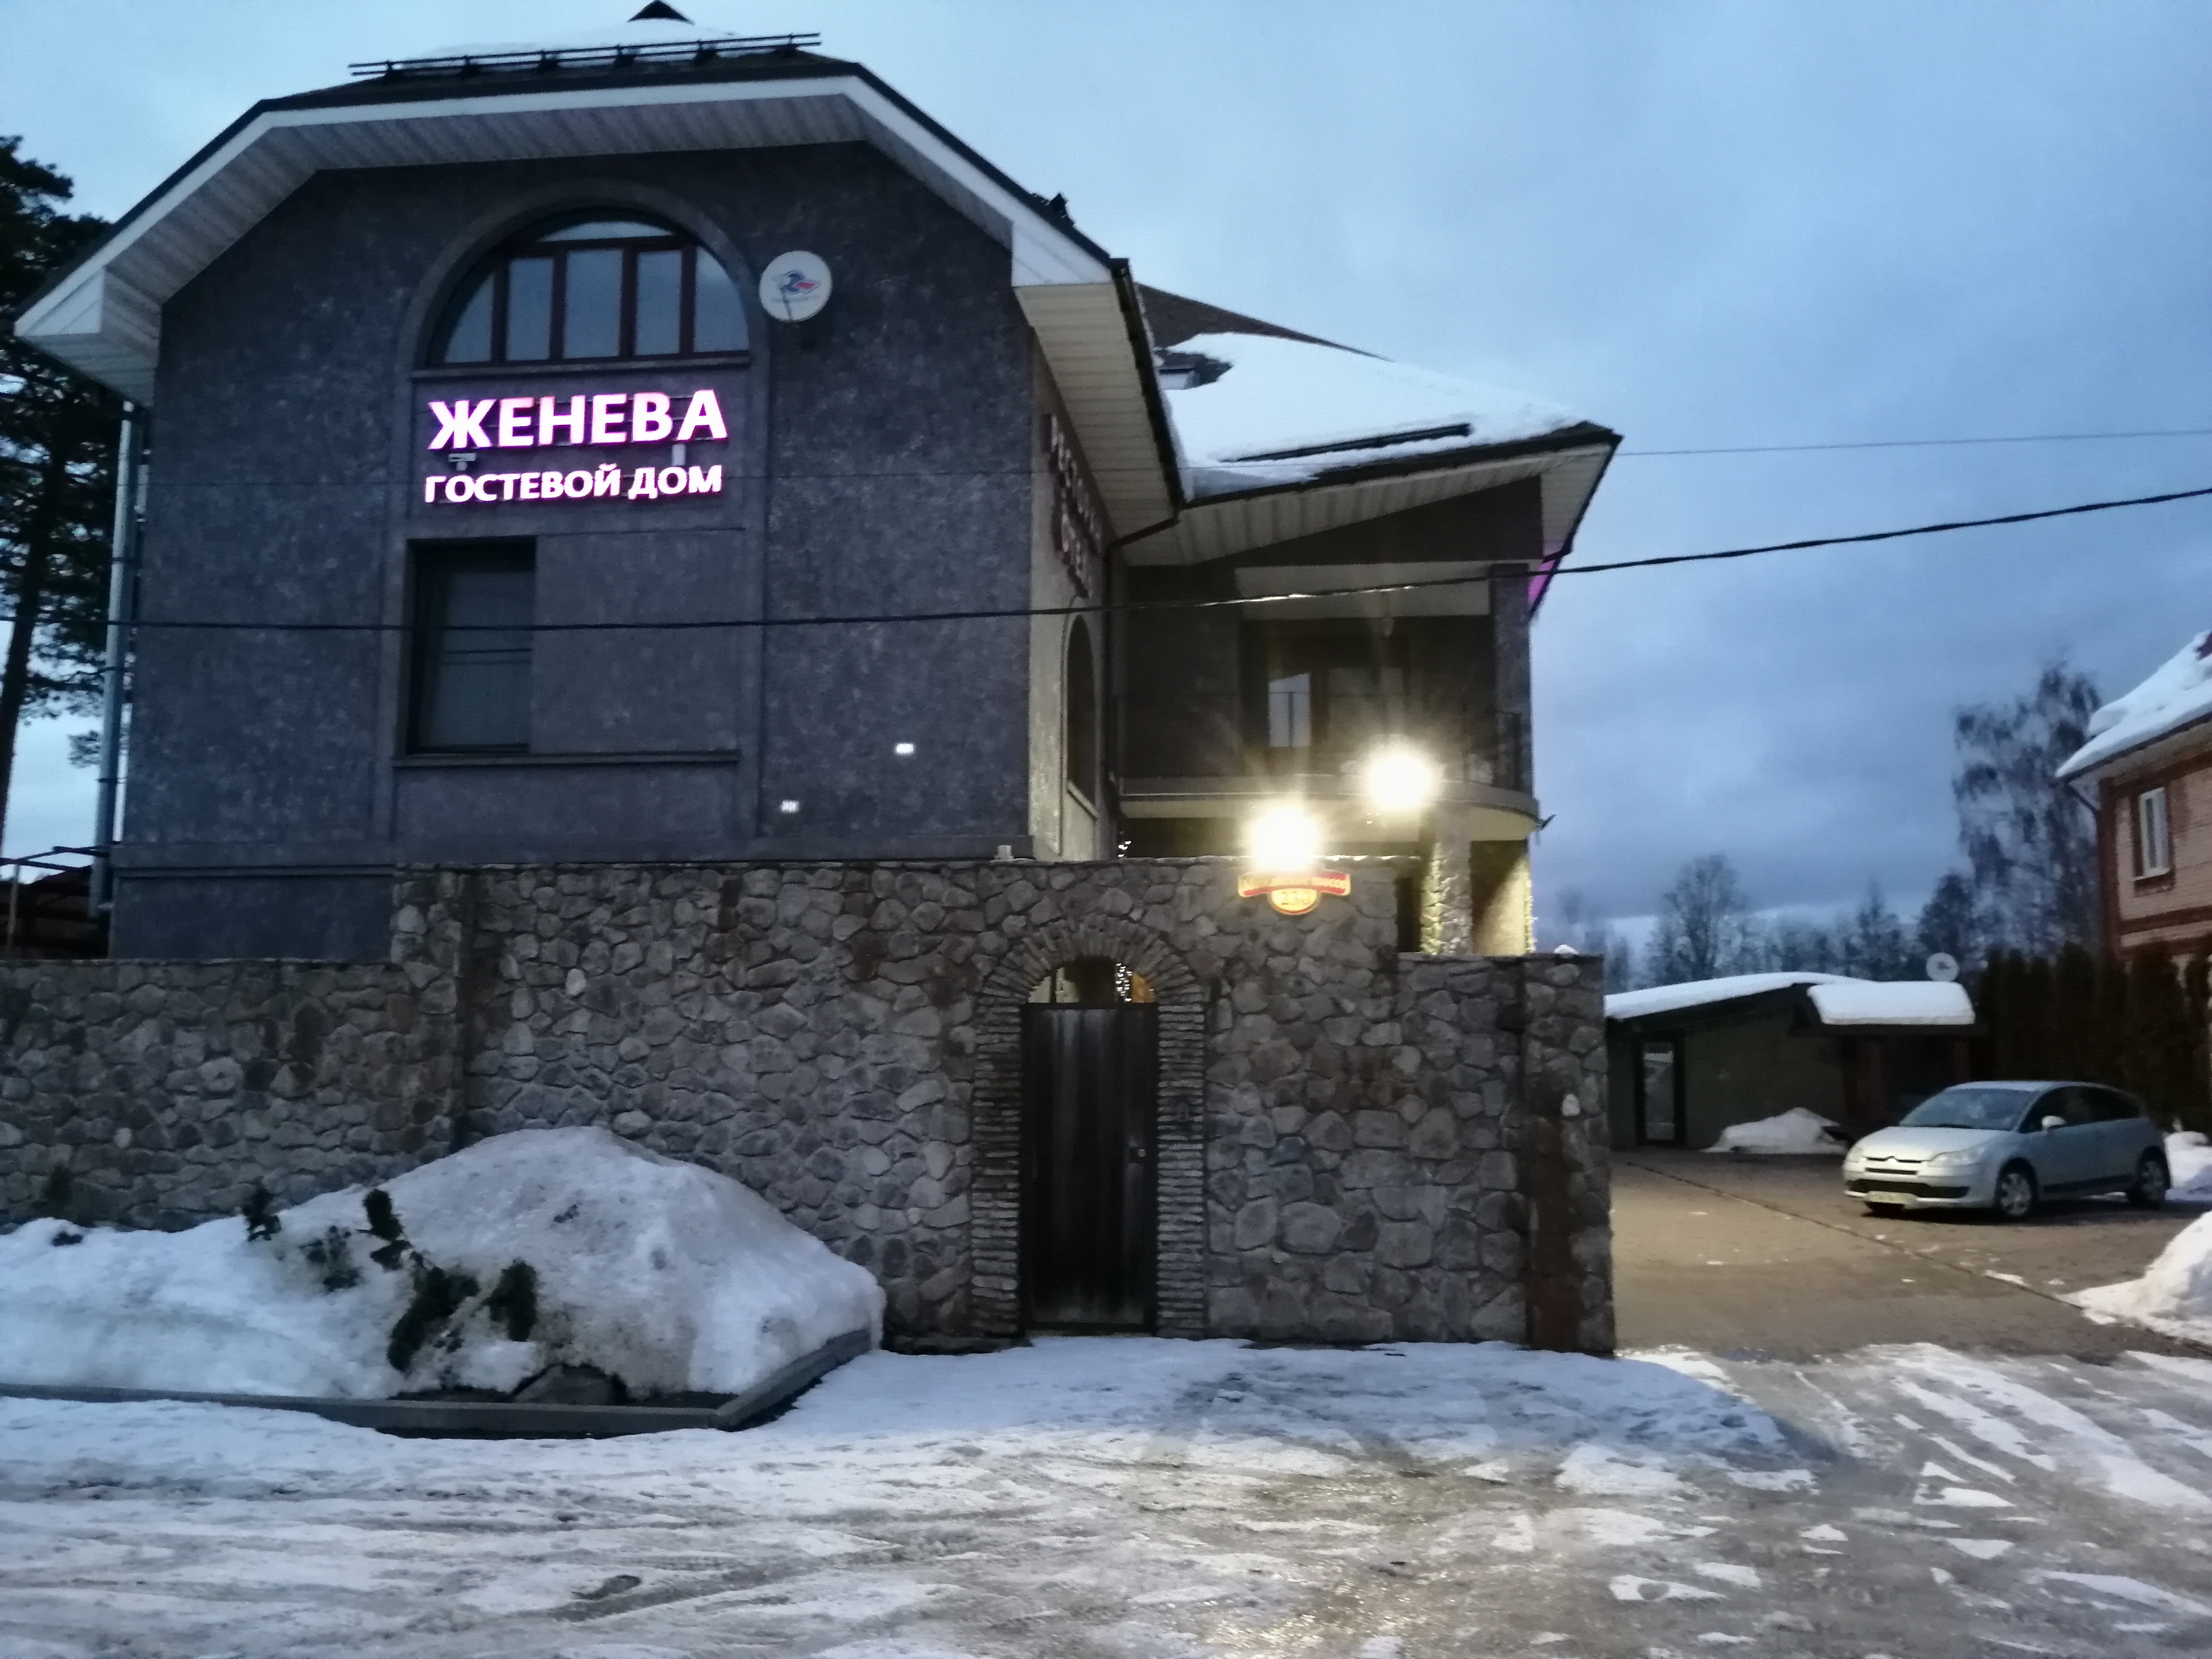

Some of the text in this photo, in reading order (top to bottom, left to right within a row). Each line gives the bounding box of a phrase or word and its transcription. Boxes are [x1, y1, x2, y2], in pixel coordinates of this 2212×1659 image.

[428, 389, 727, 450] ЖЕНЕВА
[424, 463, 722, 503] ГОСТЕВОЙ ДОМ
